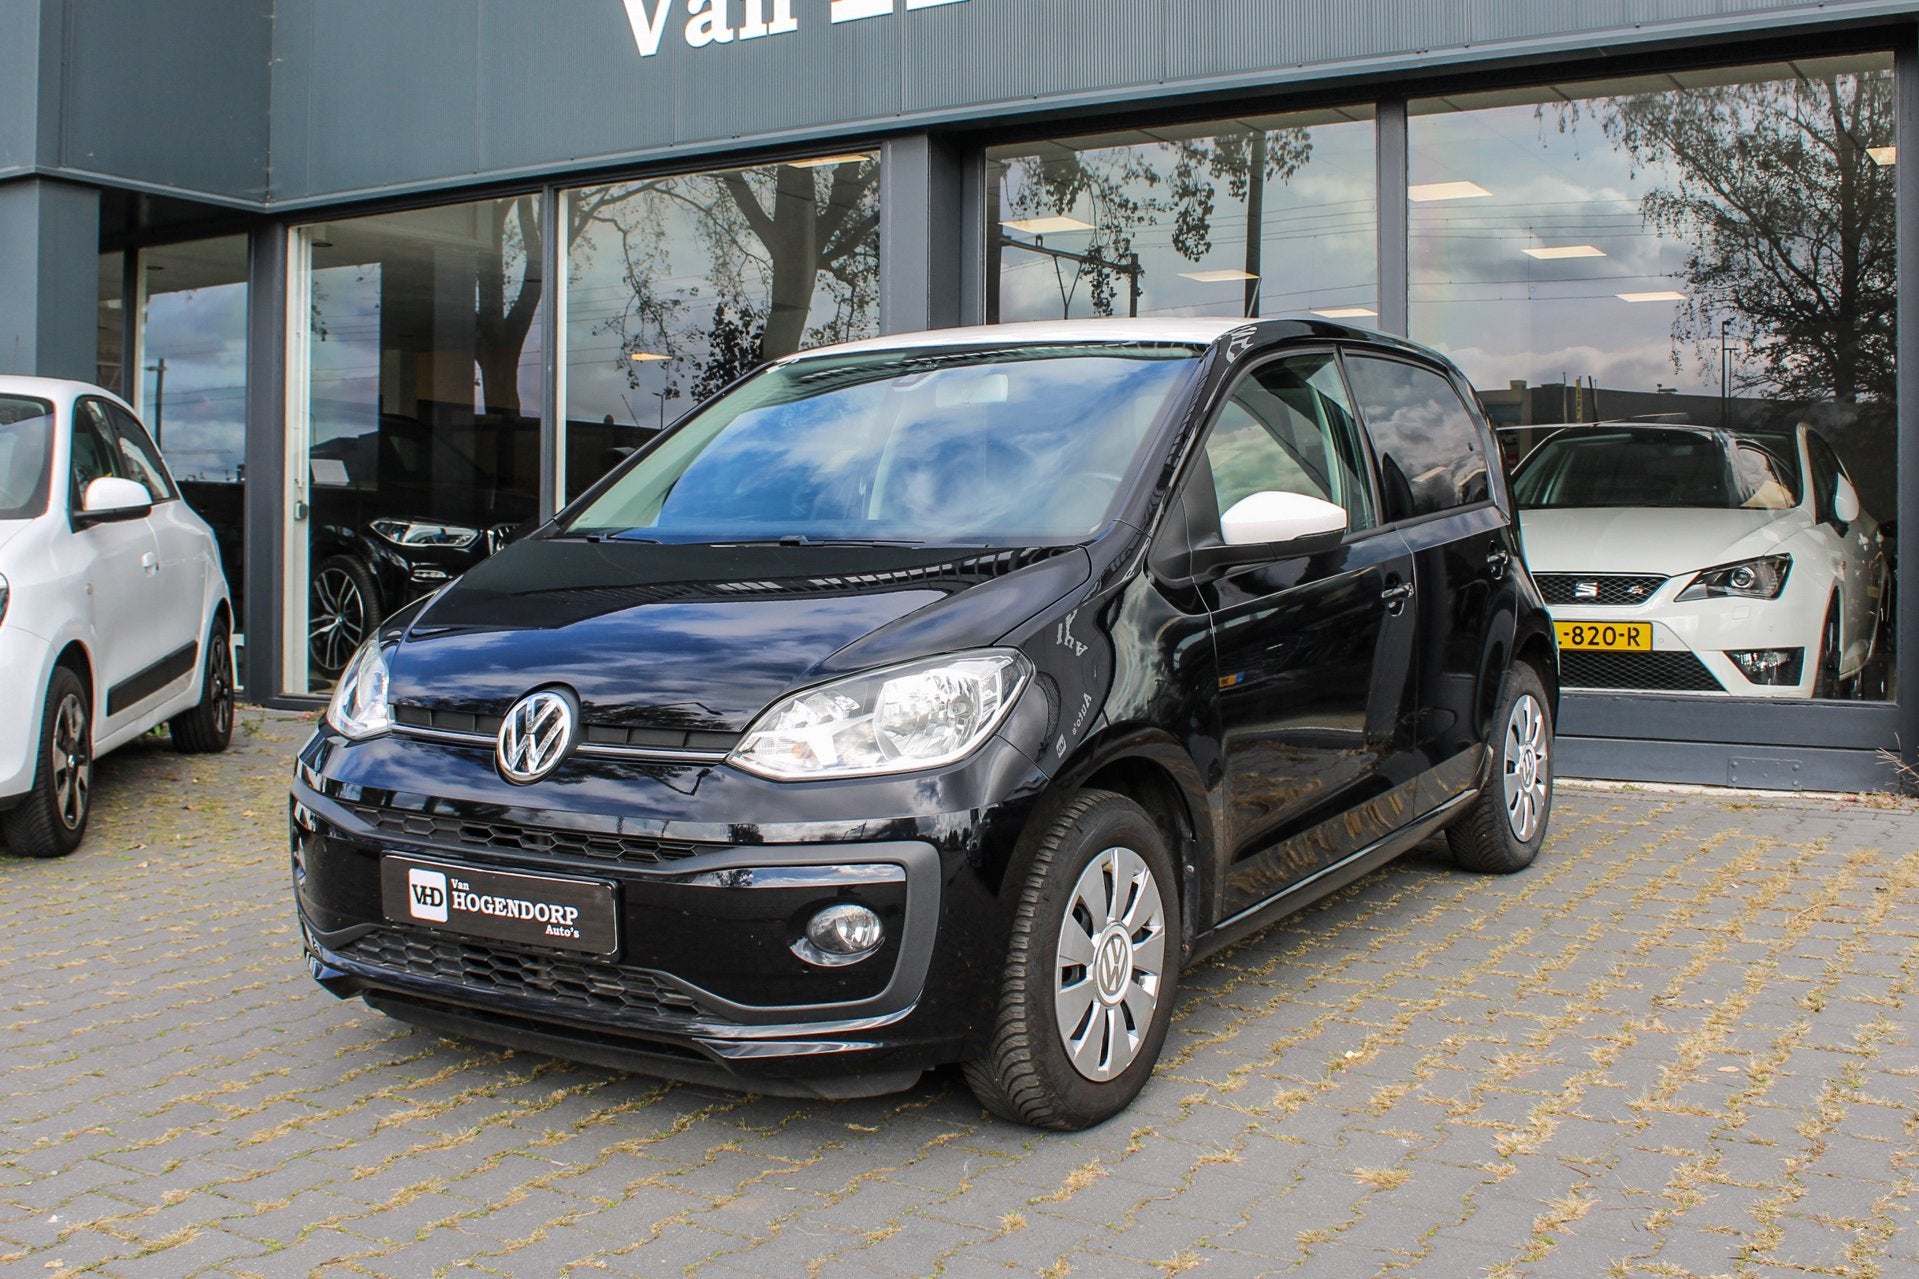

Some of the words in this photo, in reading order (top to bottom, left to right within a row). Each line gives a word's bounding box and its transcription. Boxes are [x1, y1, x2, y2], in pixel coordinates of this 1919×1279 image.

[1558, 625, 1640, 647] -820-R
[451, 878, 470, 891] Van
[452, 891, 578, 925] HOGENDORP
[545, 924, 580, 938] Auto's
